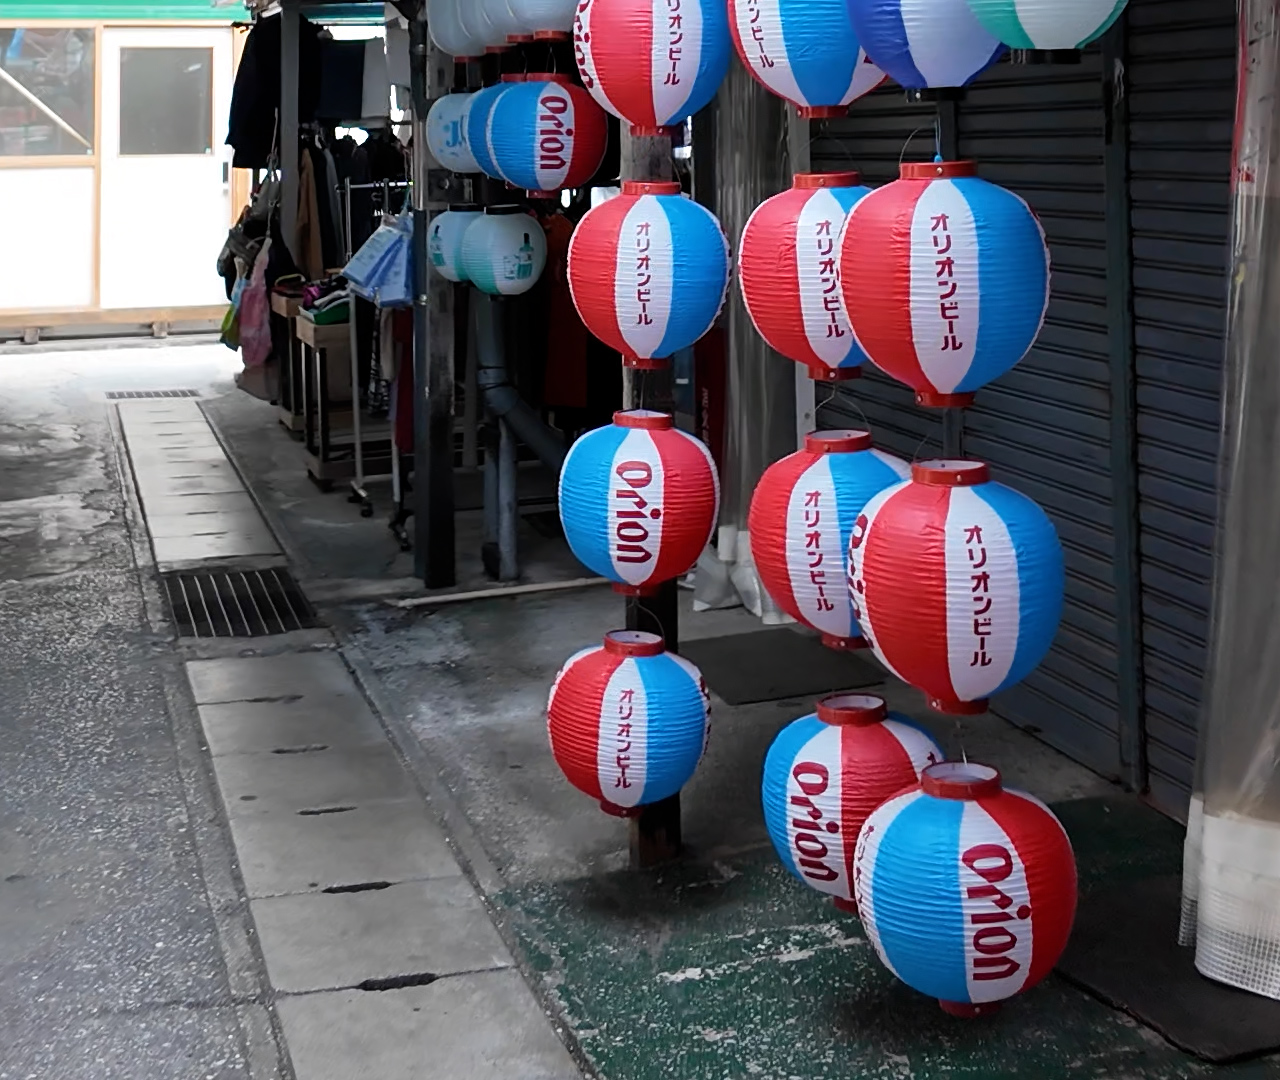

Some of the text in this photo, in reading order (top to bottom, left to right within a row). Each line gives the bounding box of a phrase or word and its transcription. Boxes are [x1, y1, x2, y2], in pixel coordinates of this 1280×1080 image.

[538, 95, 575, 171] Orion
[636, 221, 653, 326] オリオンビール
[815, 219, 845, 339] オリオンビール
[929, 212, 963, 352] オリオンビール
[615, 460, 662, 564] Orion
[804, 490, 835, 612] オリオンビール
[963, 524, 993, 667] オリオンビール
[614, 688, 636, 789] オリオンビール
[790, 761, 840, 882] Orion
[961, 843, 1032, 981] Orion
